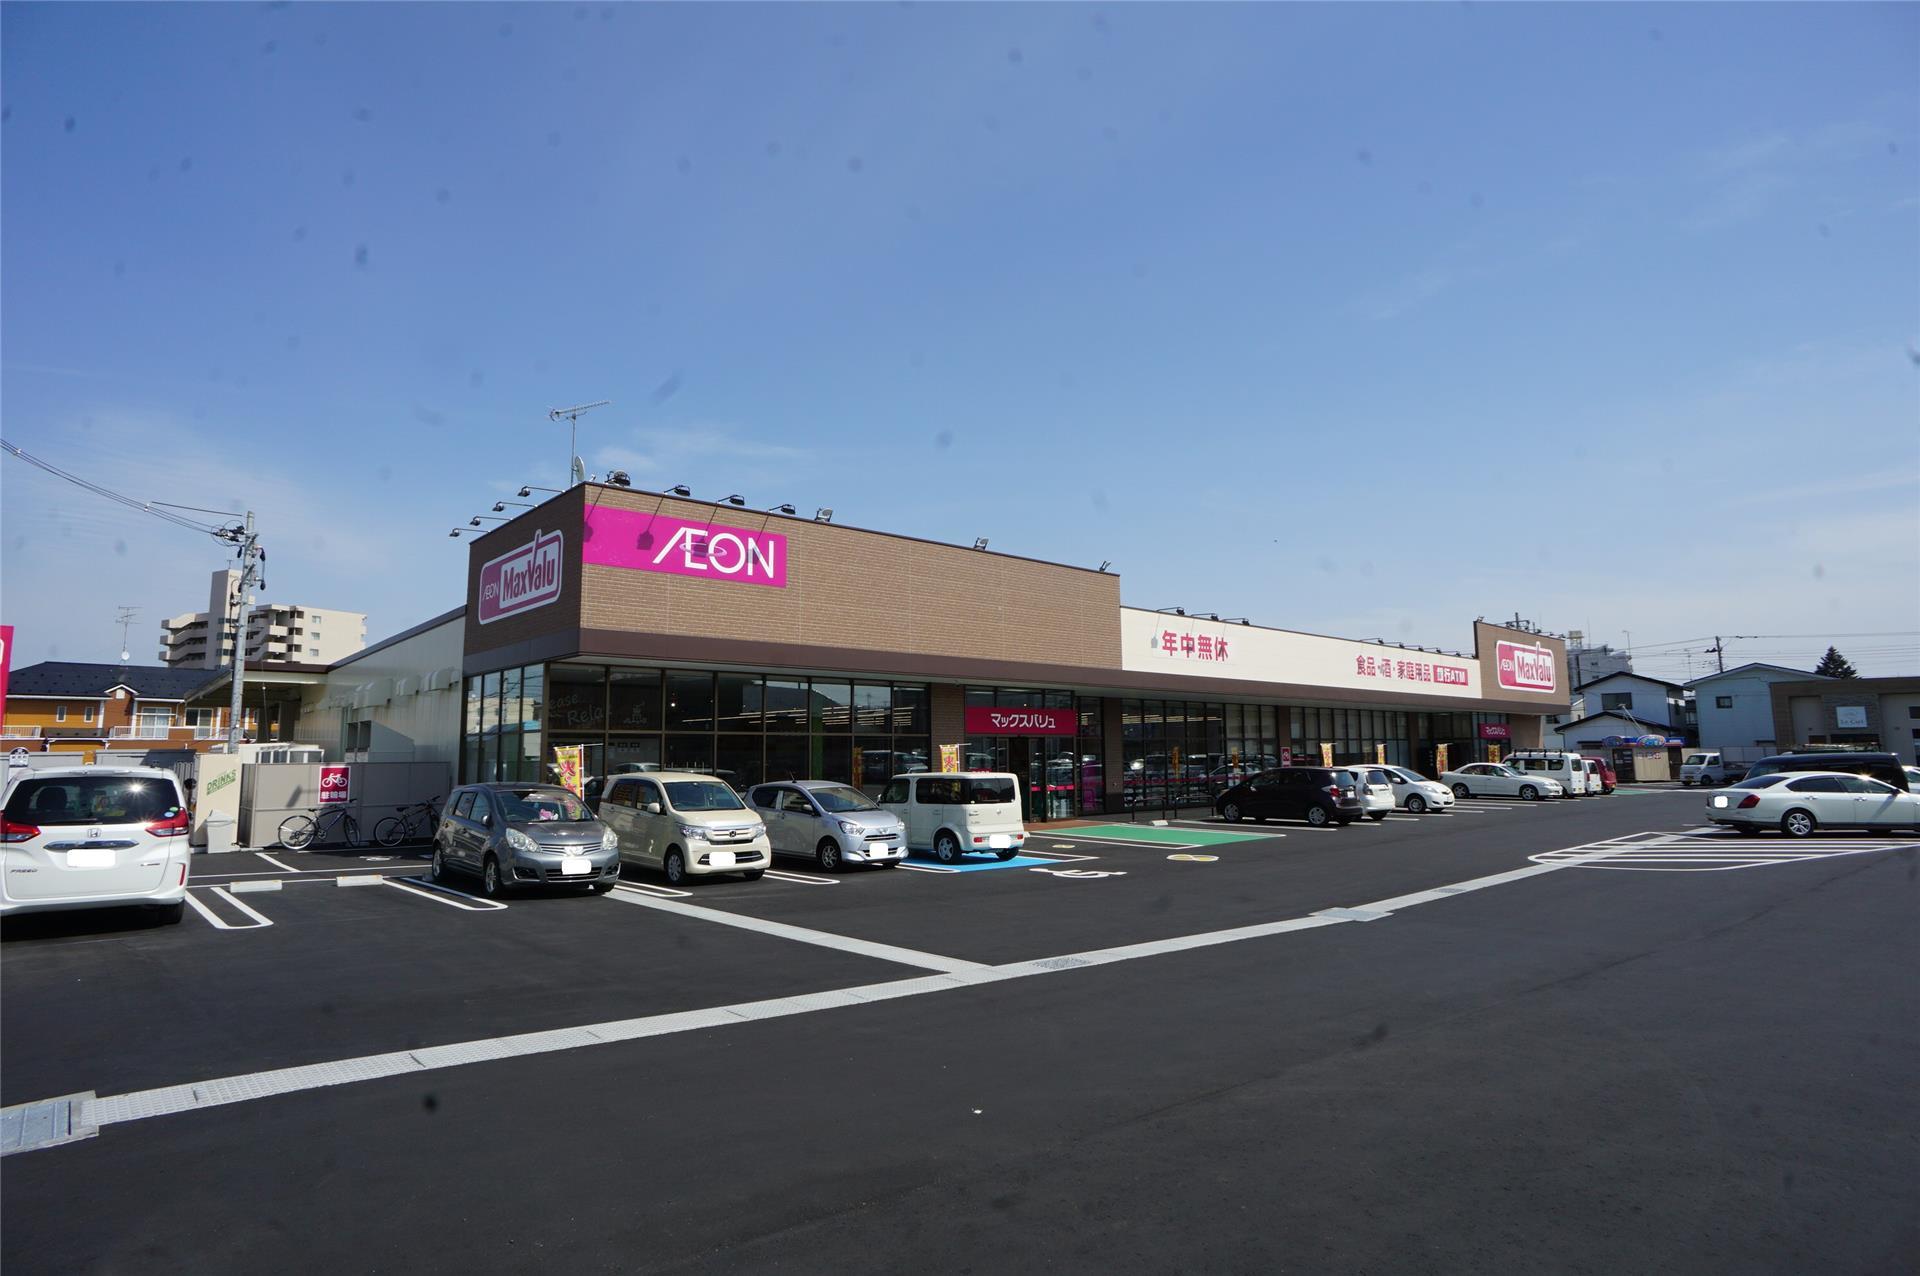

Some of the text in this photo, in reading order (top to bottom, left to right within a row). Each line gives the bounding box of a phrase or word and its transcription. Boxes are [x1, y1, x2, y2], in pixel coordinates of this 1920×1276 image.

[503, 533, 555, 602] MaxValu
[1161, 629, 1229, 661] 年中無休
[1517, 644, 1552, 682] MaxValu
[990, 713, 1056, 729] マックスバリュ
[206, 769, 237, 792] DRINKS
